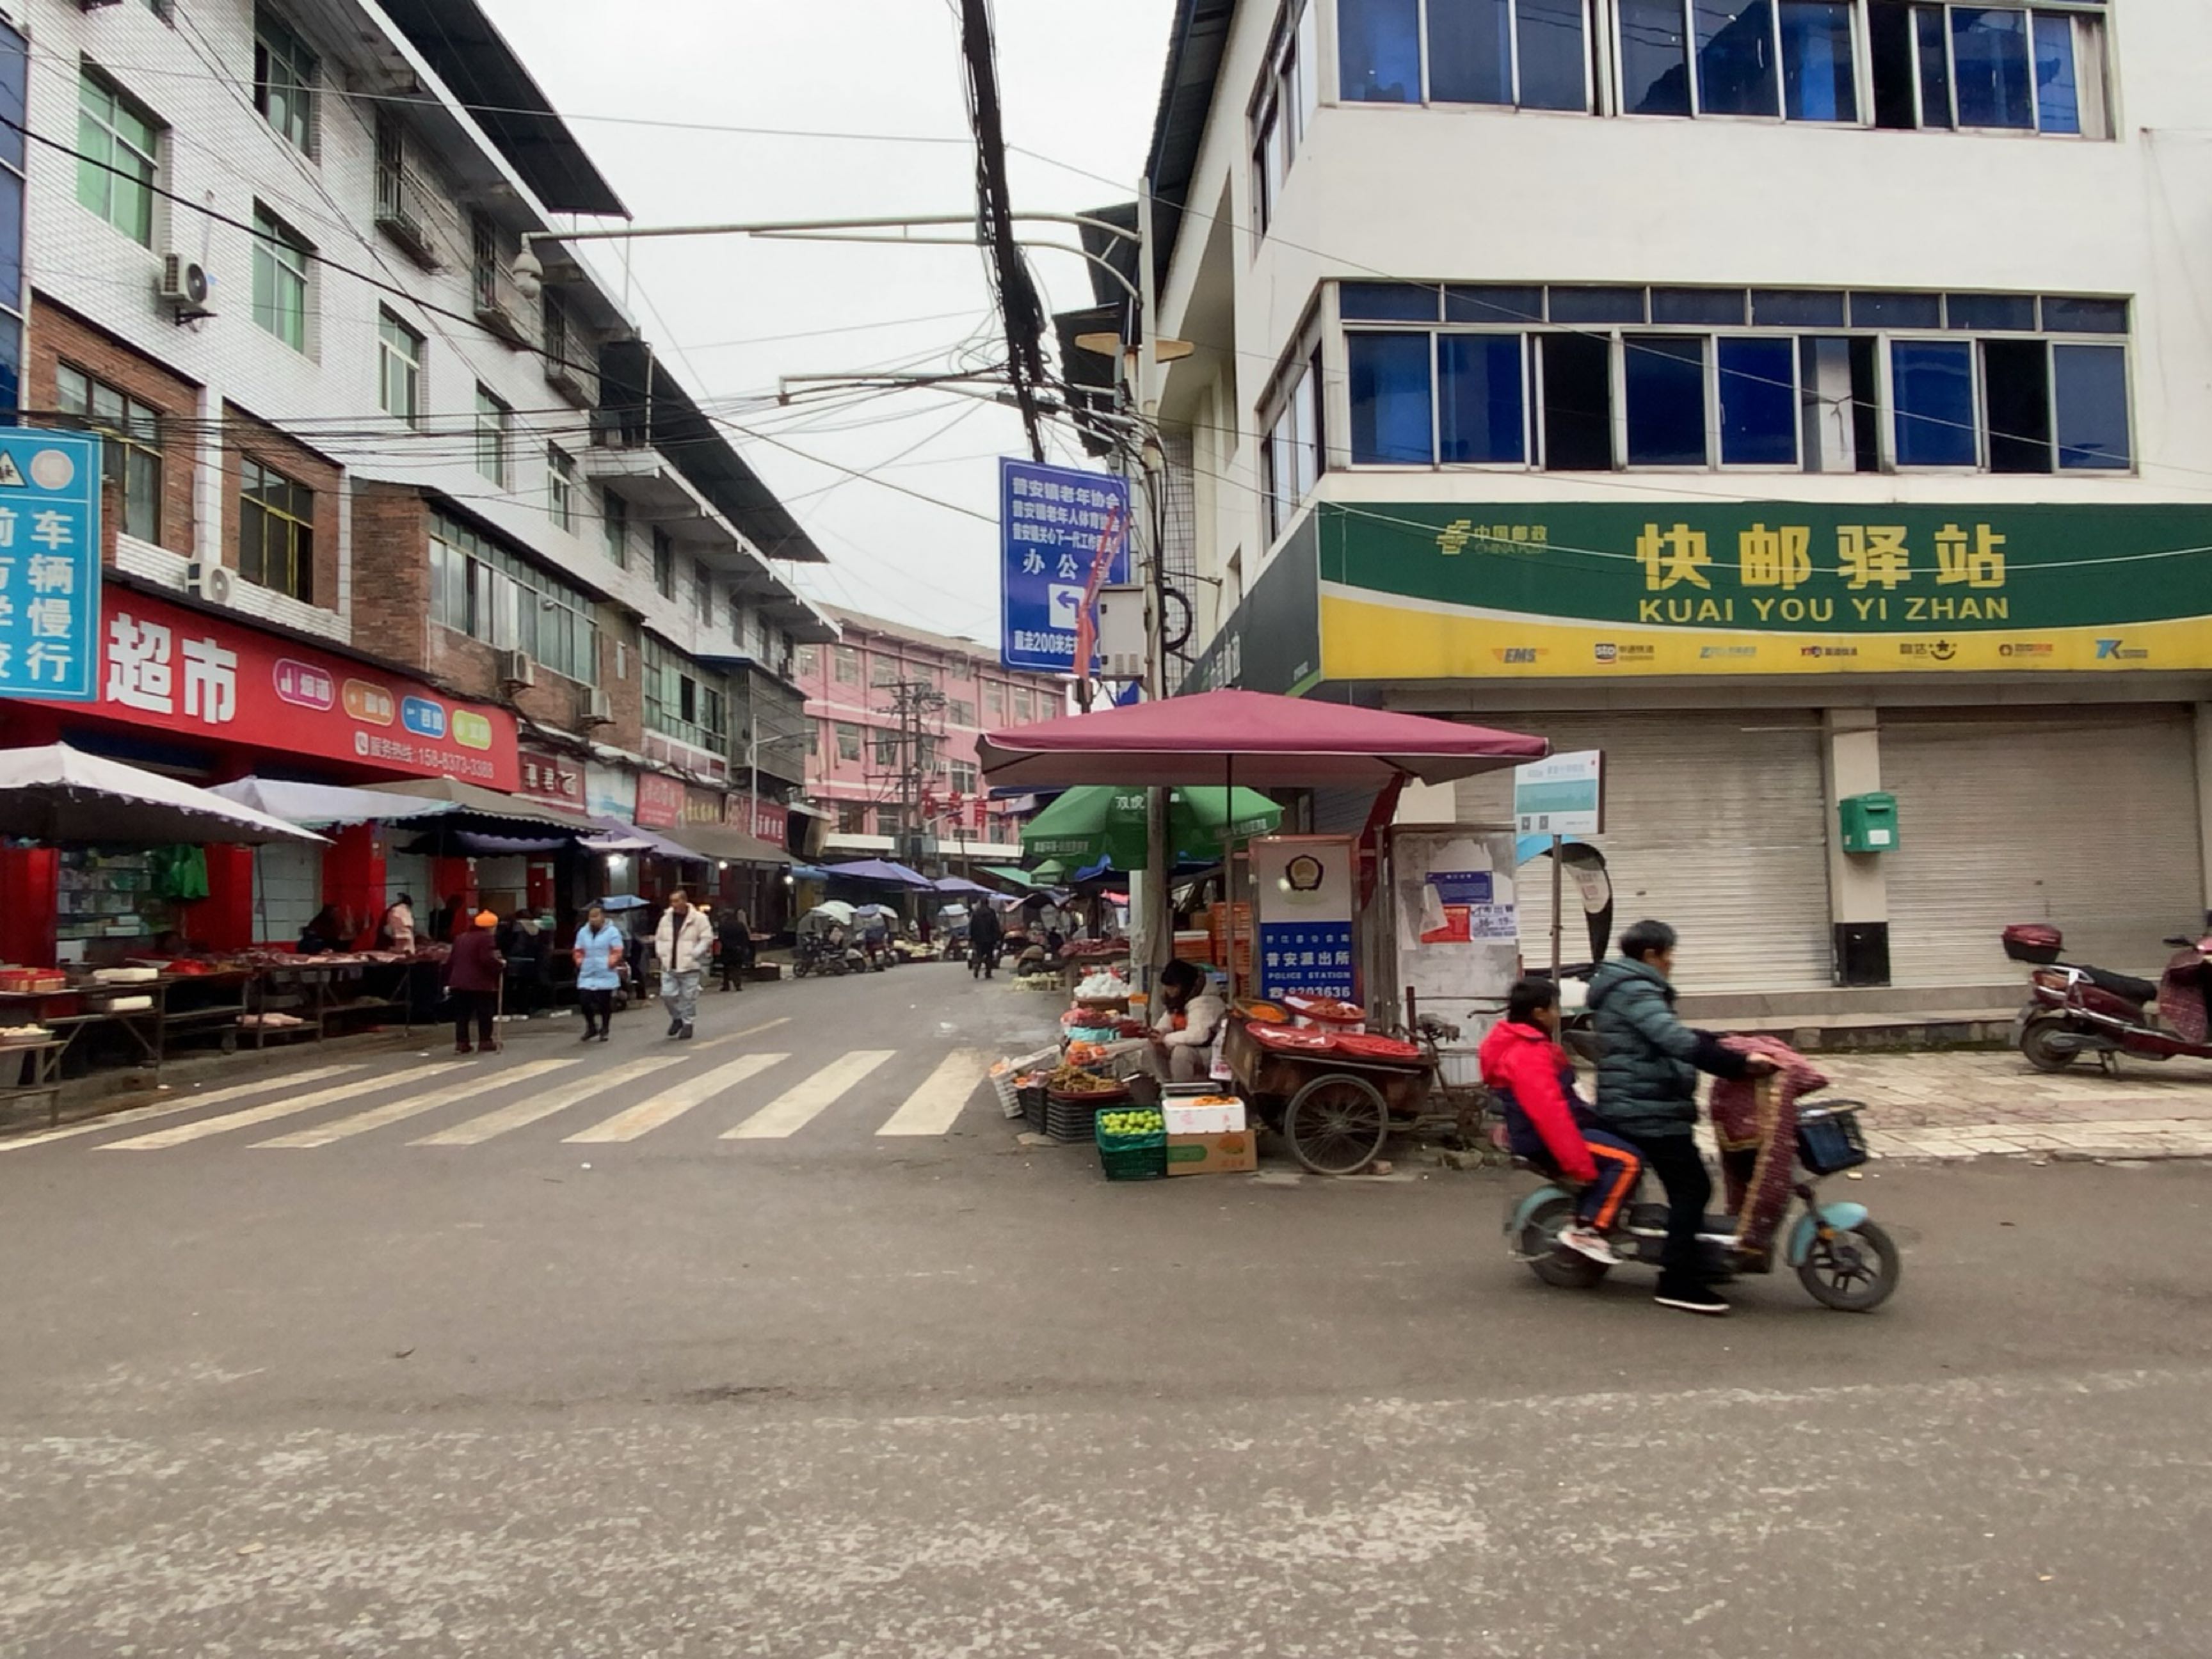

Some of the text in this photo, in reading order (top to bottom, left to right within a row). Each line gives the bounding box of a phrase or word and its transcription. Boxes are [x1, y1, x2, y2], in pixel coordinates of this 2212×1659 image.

[1475, 525, 1547, 541] 中国邮政
[1636, 523, 2006, 590] 快邮驿站
[26, 510, 74, 682] 车辆慢行
[1640, 597, 2009, 622] KUAI YOU YI ZHAN
[106, 612, 237, 723] 超市
[1504, 648, 1537, 663] EMS
[1266, 950, 1350, 967] 普安派出所
